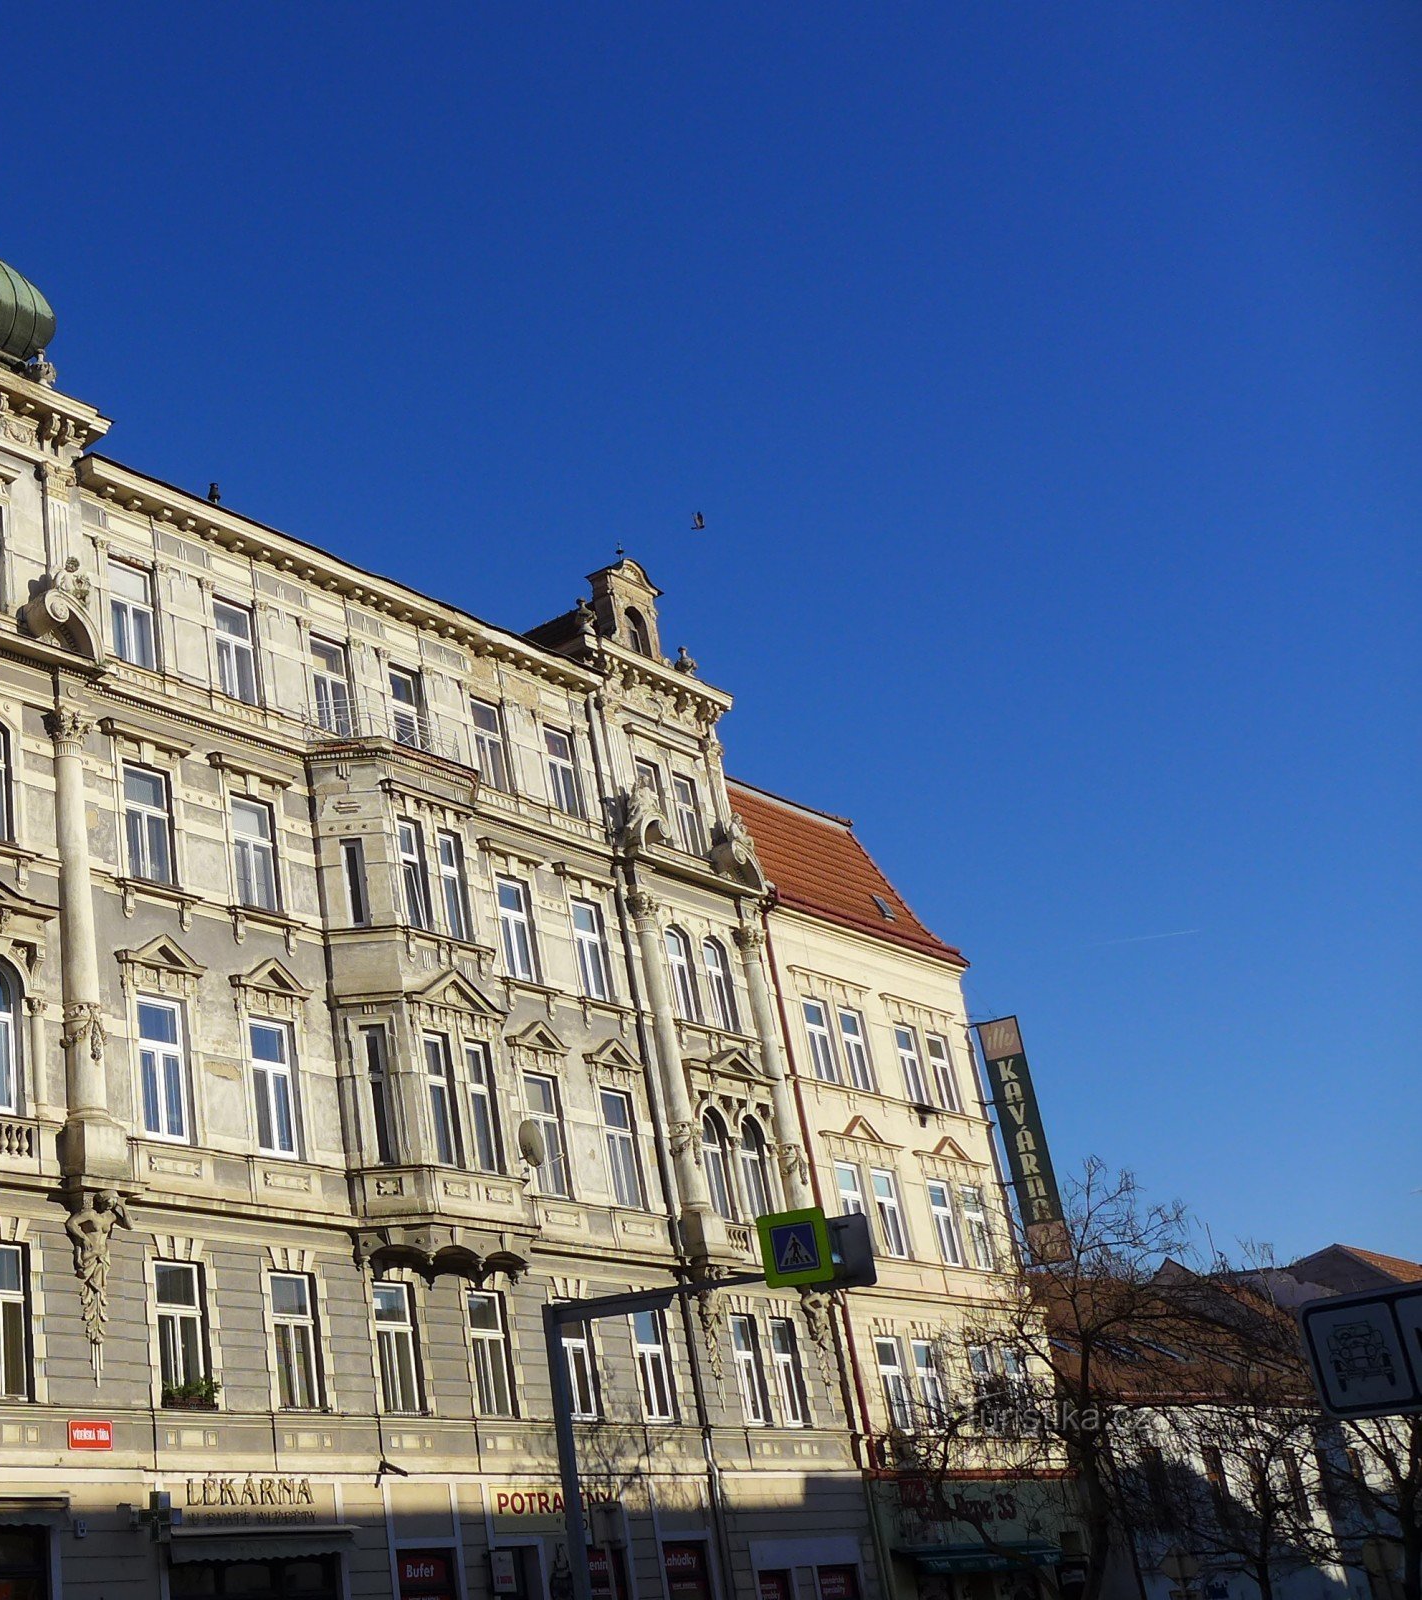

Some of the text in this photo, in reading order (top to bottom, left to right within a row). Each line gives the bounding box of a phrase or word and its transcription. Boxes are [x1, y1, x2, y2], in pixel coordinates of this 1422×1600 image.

[987, 1026, 1016, 1052] illy
[997, 1058, 1052, 1221] KAVÁRNA
[186, 1472, 315, 1506] LÉKÁRNA
[496, 1491, 613, 1515] POTRAINY
[995, 1491, 1017, 1520] 33
[405, 1563, 435, 1579] Bufet
